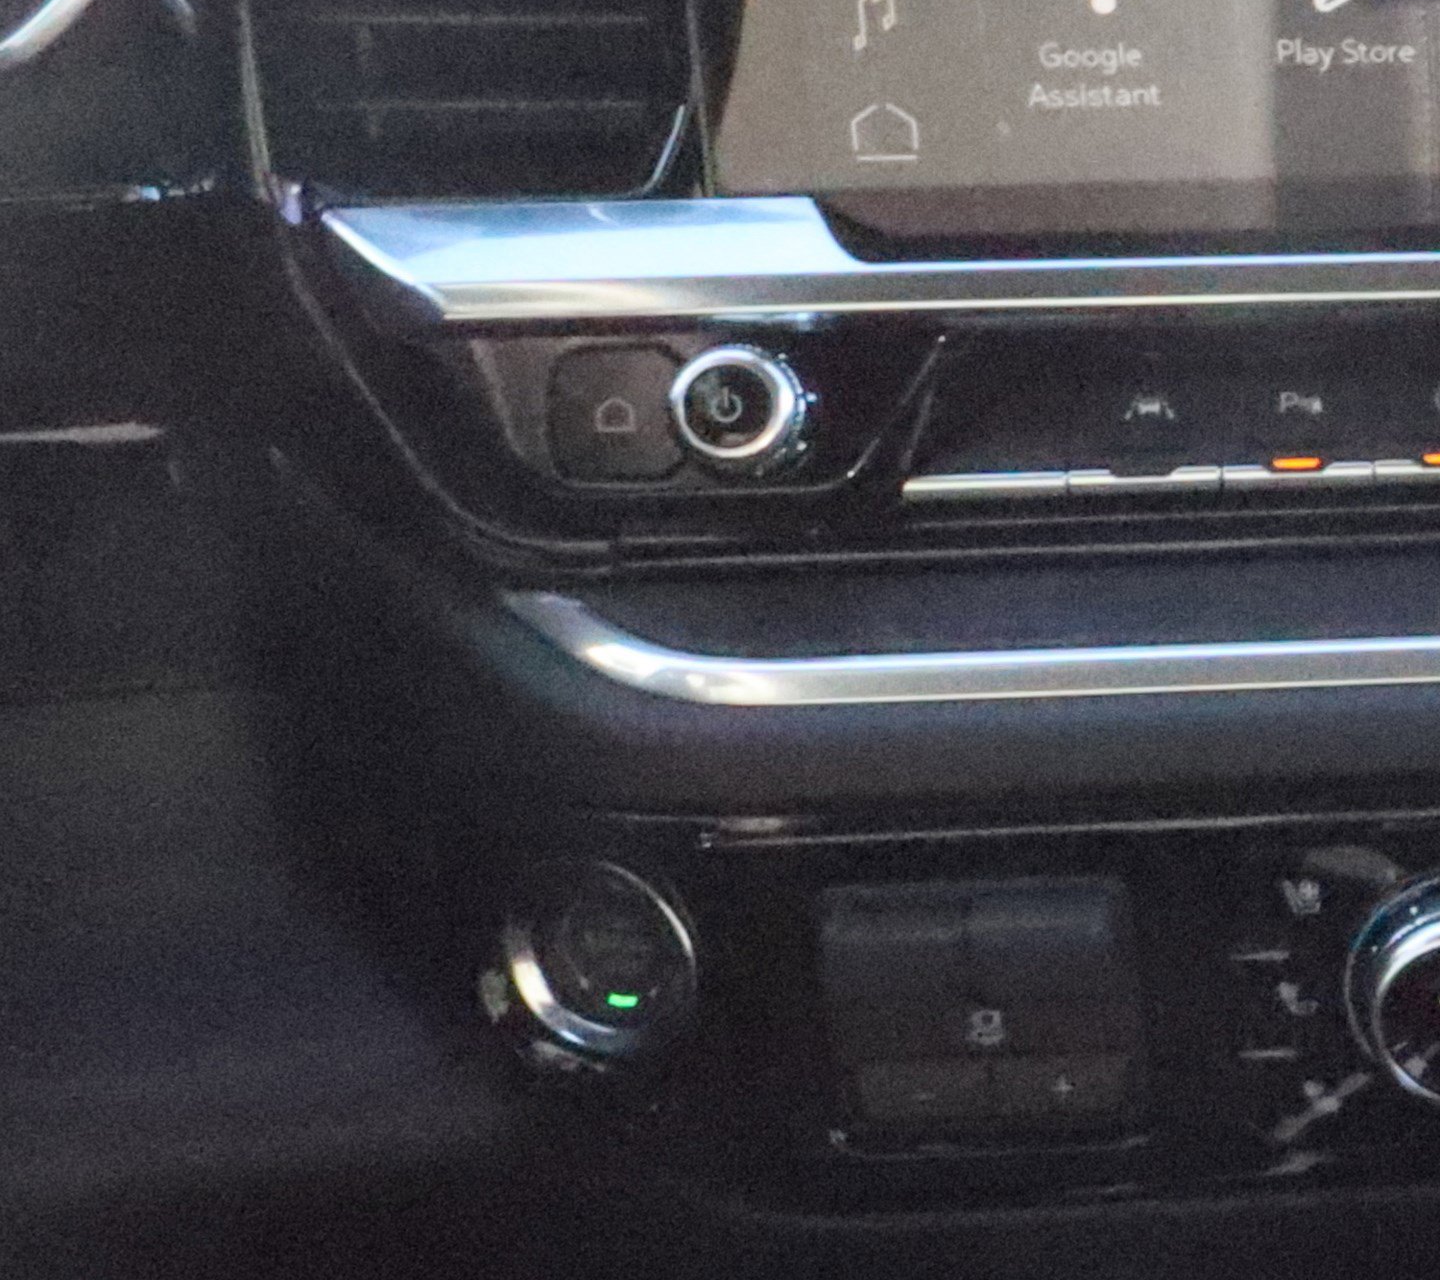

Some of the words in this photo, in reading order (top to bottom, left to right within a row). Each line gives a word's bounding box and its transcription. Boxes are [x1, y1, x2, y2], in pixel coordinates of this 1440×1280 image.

[1039, 40, 1143, 76] Google
[1277, 38, 1336, 71] Play
[1343, 37, 1416, 64] Store
[1029, 81, 1162, 109] Assistant
